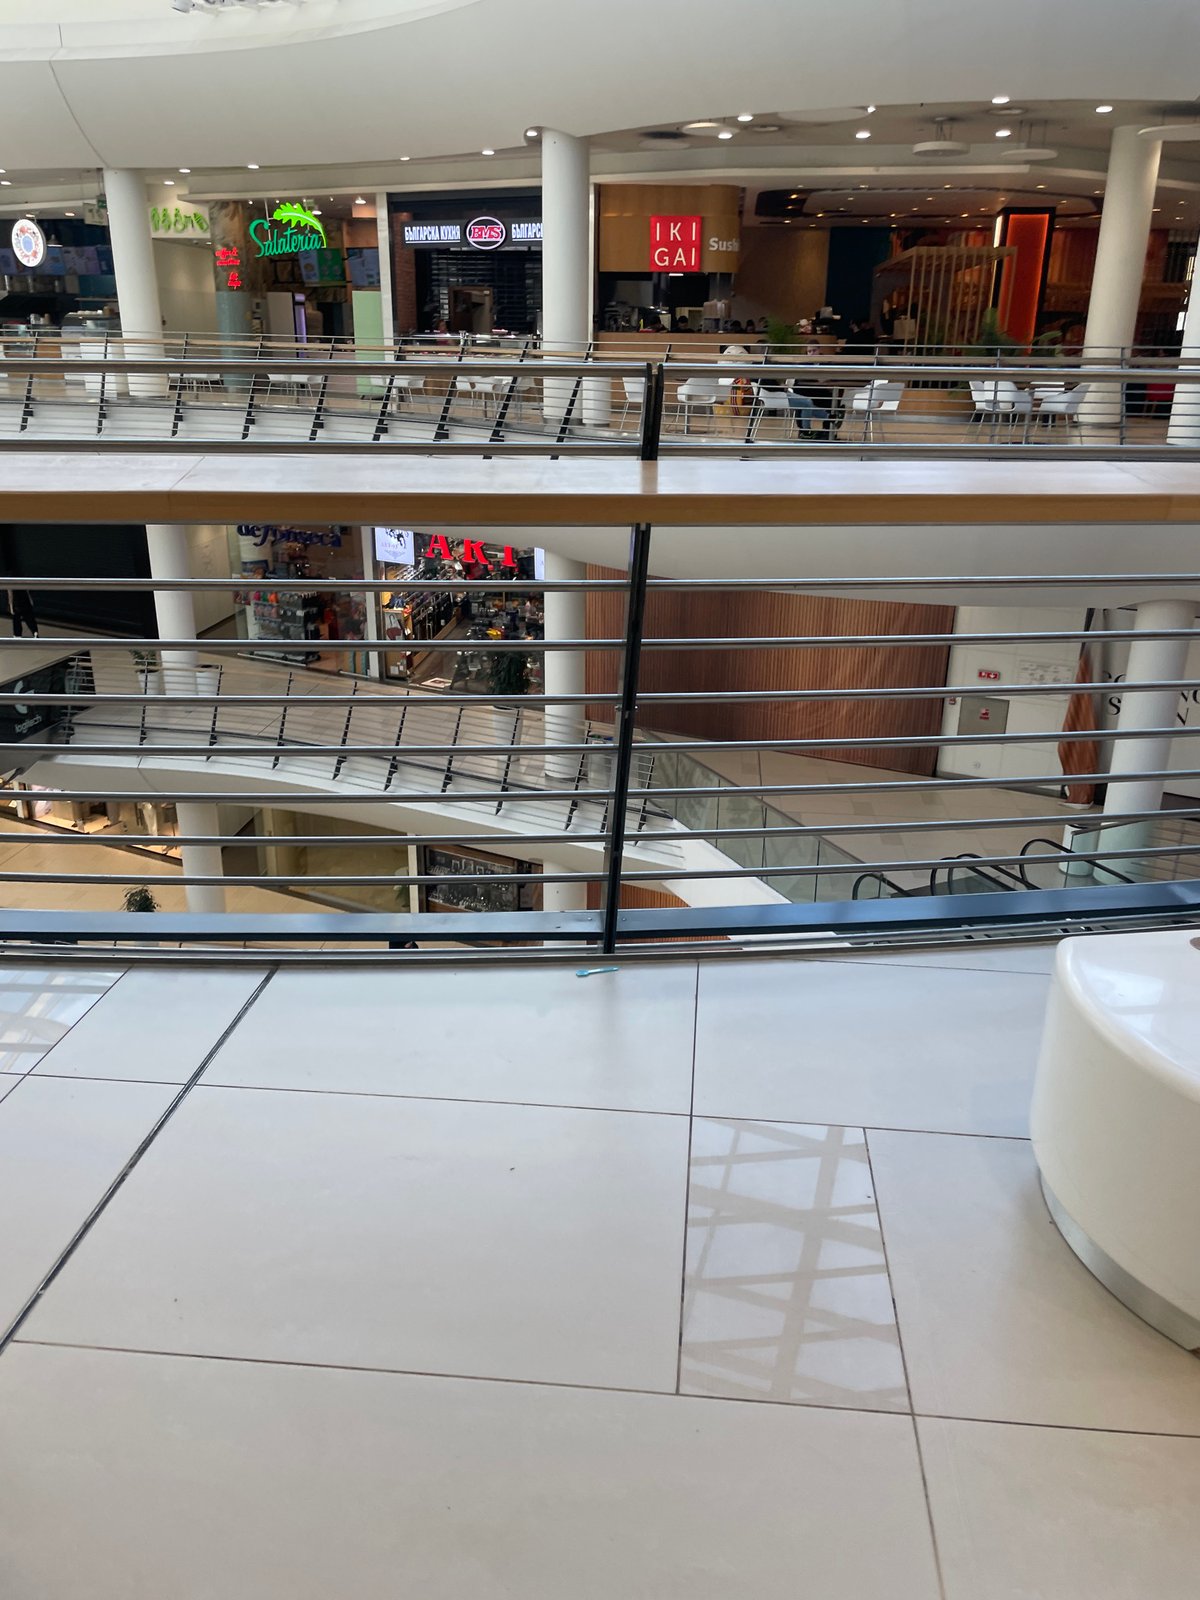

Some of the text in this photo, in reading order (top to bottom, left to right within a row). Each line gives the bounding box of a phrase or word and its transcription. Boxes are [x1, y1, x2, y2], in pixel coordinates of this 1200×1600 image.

[249, 219, 322, 257] Salateria
[405, 225, 460, 240] БЪЛГАРСКА КУХНЯ
[656, 222, 696, 241] IKI
[654, 247, 696, 266] GAI
